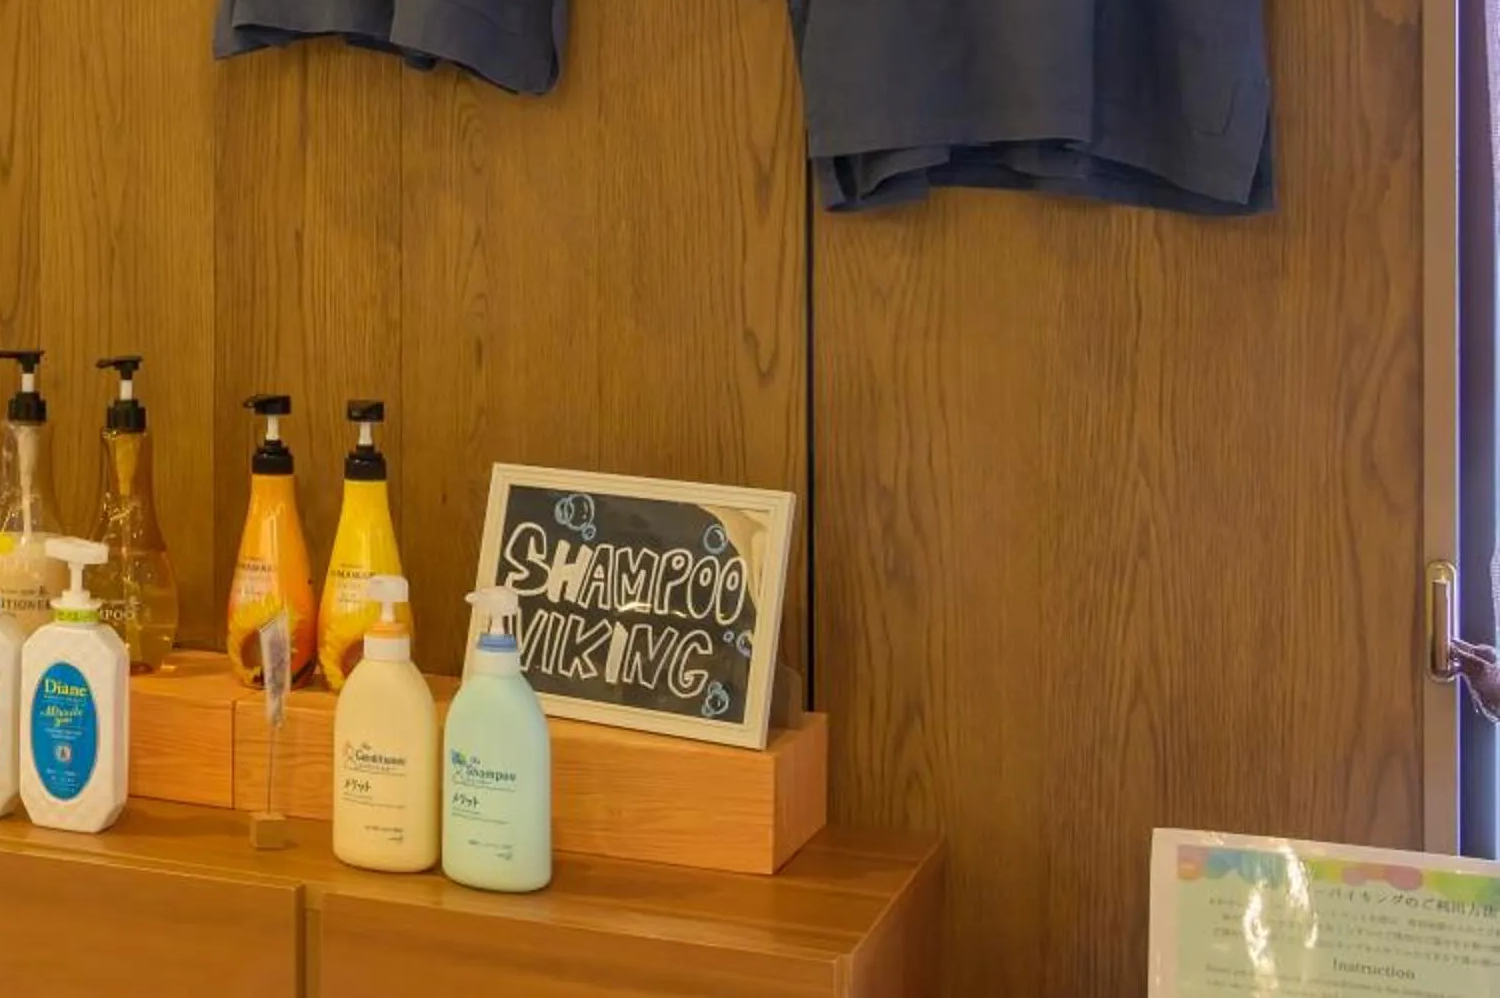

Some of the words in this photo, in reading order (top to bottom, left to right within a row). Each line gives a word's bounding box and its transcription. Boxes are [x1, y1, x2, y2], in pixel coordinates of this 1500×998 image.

[504, 522, 747, 626] SHAMPOO
[518, 608, 714, 699] VIKING
[45, 678, 88, 697] Diane
[1333, 956, 1416, 981] Instruction
